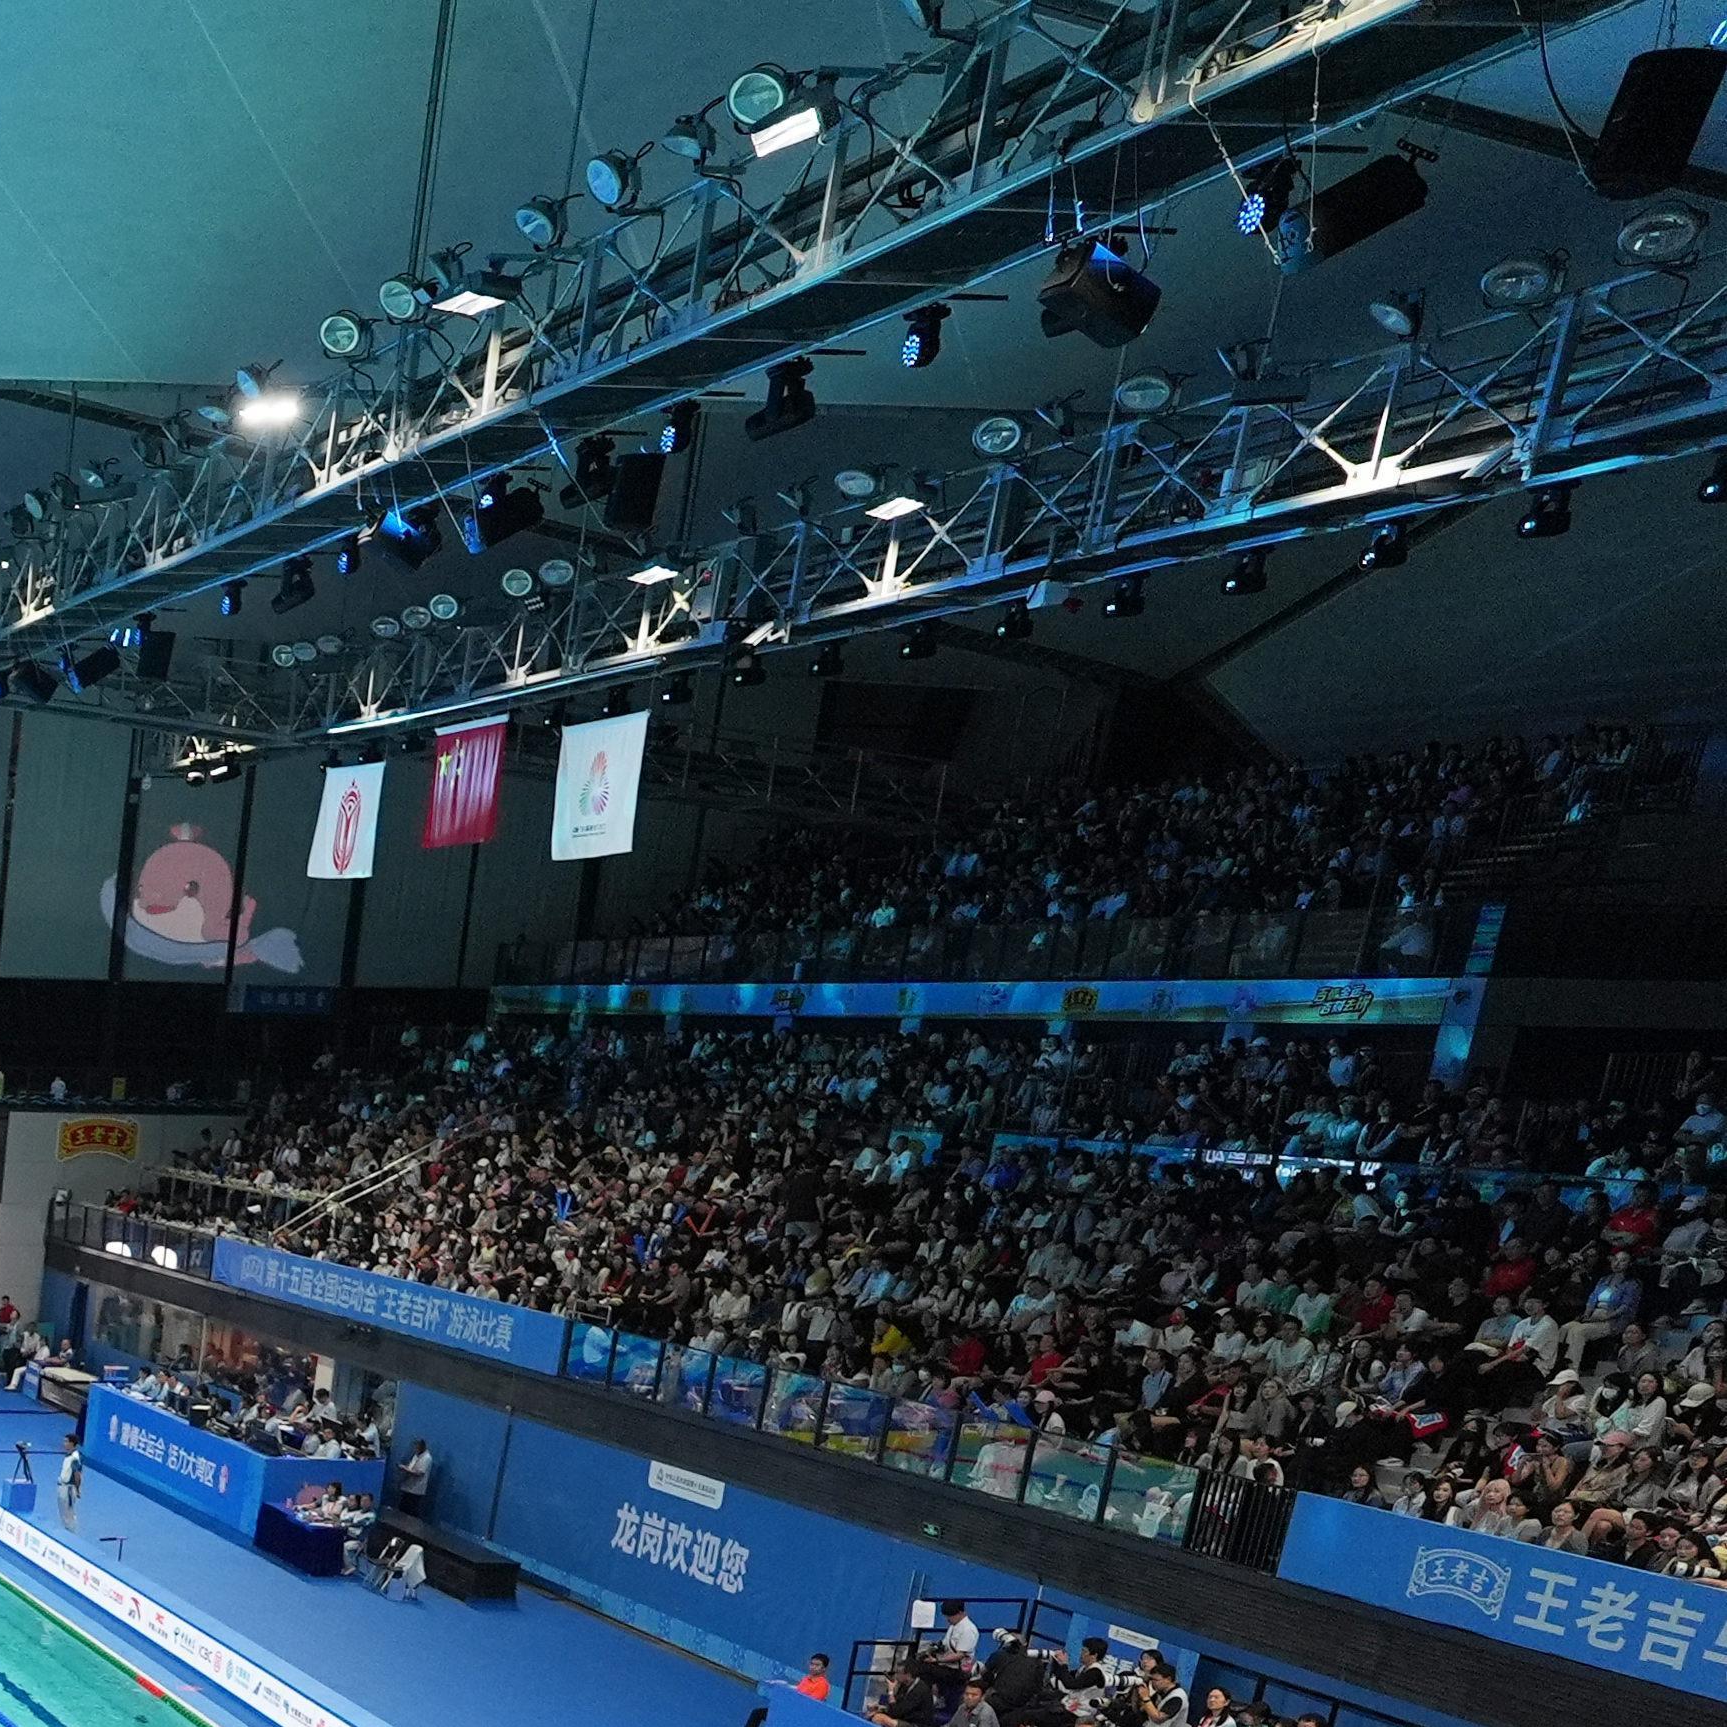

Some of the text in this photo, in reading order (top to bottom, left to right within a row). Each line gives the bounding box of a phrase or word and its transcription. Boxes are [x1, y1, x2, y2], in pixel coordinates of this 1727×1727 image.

[610, 1501, 750, 1594] 龙岗欢迎您
[1428, 1558, 1491, 1594] 王老吉
